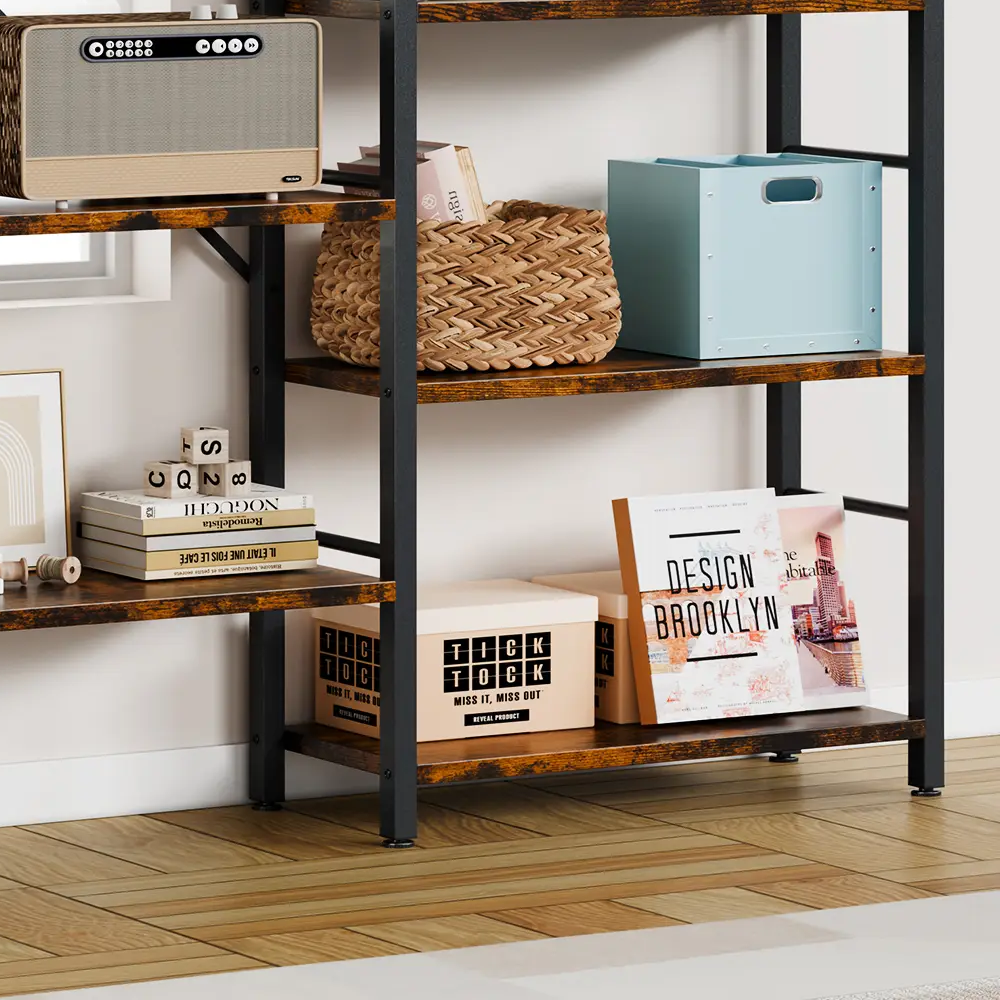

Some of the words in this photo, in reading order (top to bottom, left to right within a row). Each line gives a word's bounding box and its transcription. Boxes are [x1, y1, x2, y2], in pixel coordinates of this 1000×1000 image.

[200, 439, 222, 456] S
[148, 470, 165, 488] C
[177, 469, 191, 490] Q
[203, 471, 220, 486] 2
[231, 472, 247, 486] 8
[184, 497, 279, 517] NOGUCHI
[202, 517, 263, 529] Remodelista
[179, 553, 199, 566] CAFÉ
[201, 552, 210, 563] LE
[211, 551, 229, 562] FOIS
[230, 549, 245, 561] UNE
[246, 548, 268, 561] ÉTAIT
[269, 547, 277, 558] IL
[666, 553, 755, 595] DESIGN
[654, 595, 779, 640] BROOKLYN
[451, 637, 544, 661] TICK
[451, 664, 544, 687] TOCK
[326, 684, 342, 697] MISS
[354, 691, 371, 704] MISS
[454, 695, 478, 706] MISS
[481, 694, 493, 705] IT,
[496, 691, 520, 703] MISS
[523, 689, 541, 700] OUT
[473, 715, 494, 723] REVEAL
[495, 712, 520, 721] PRODUCT
